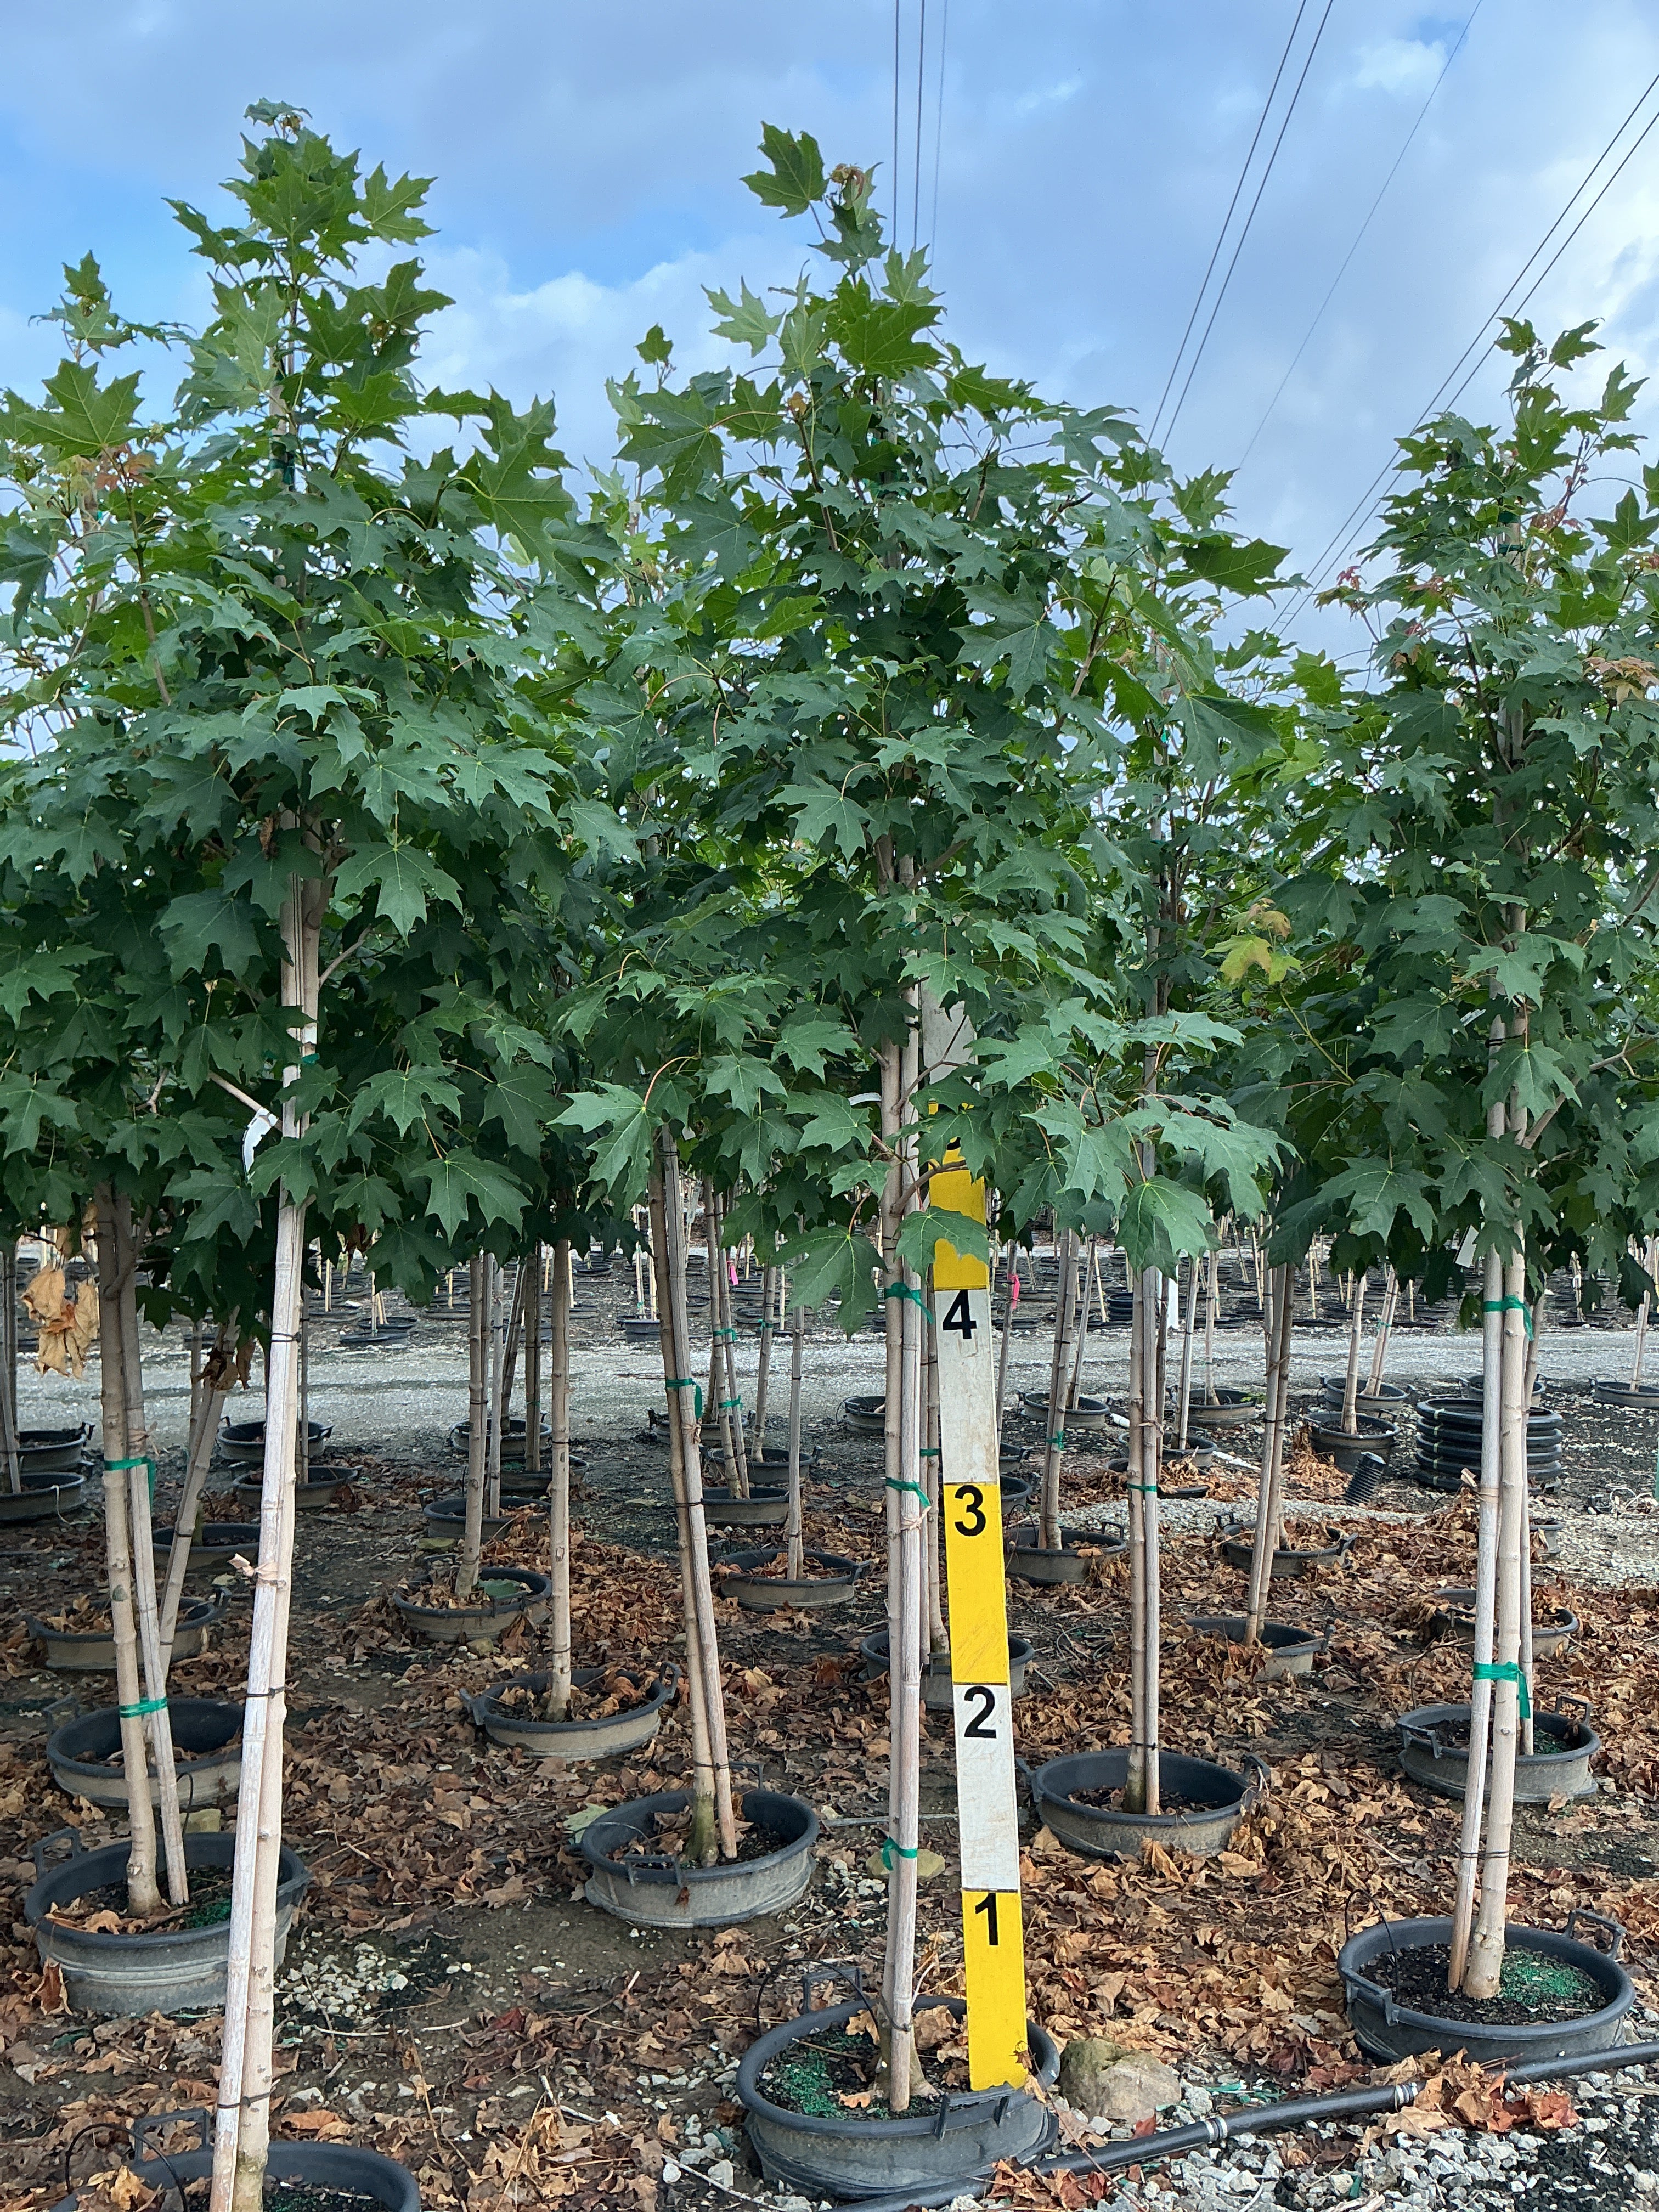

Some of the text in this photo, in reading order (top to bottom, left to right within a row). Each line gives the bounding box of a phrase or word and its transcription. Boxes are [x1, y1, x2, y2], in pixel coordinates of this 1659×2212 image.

[943, 1289, 977, 1339] 4
[955, 1485, 986, 1536] 3
[964, 1686, 996, 1738] 2
[975, 1893, 998, 1945] 1
